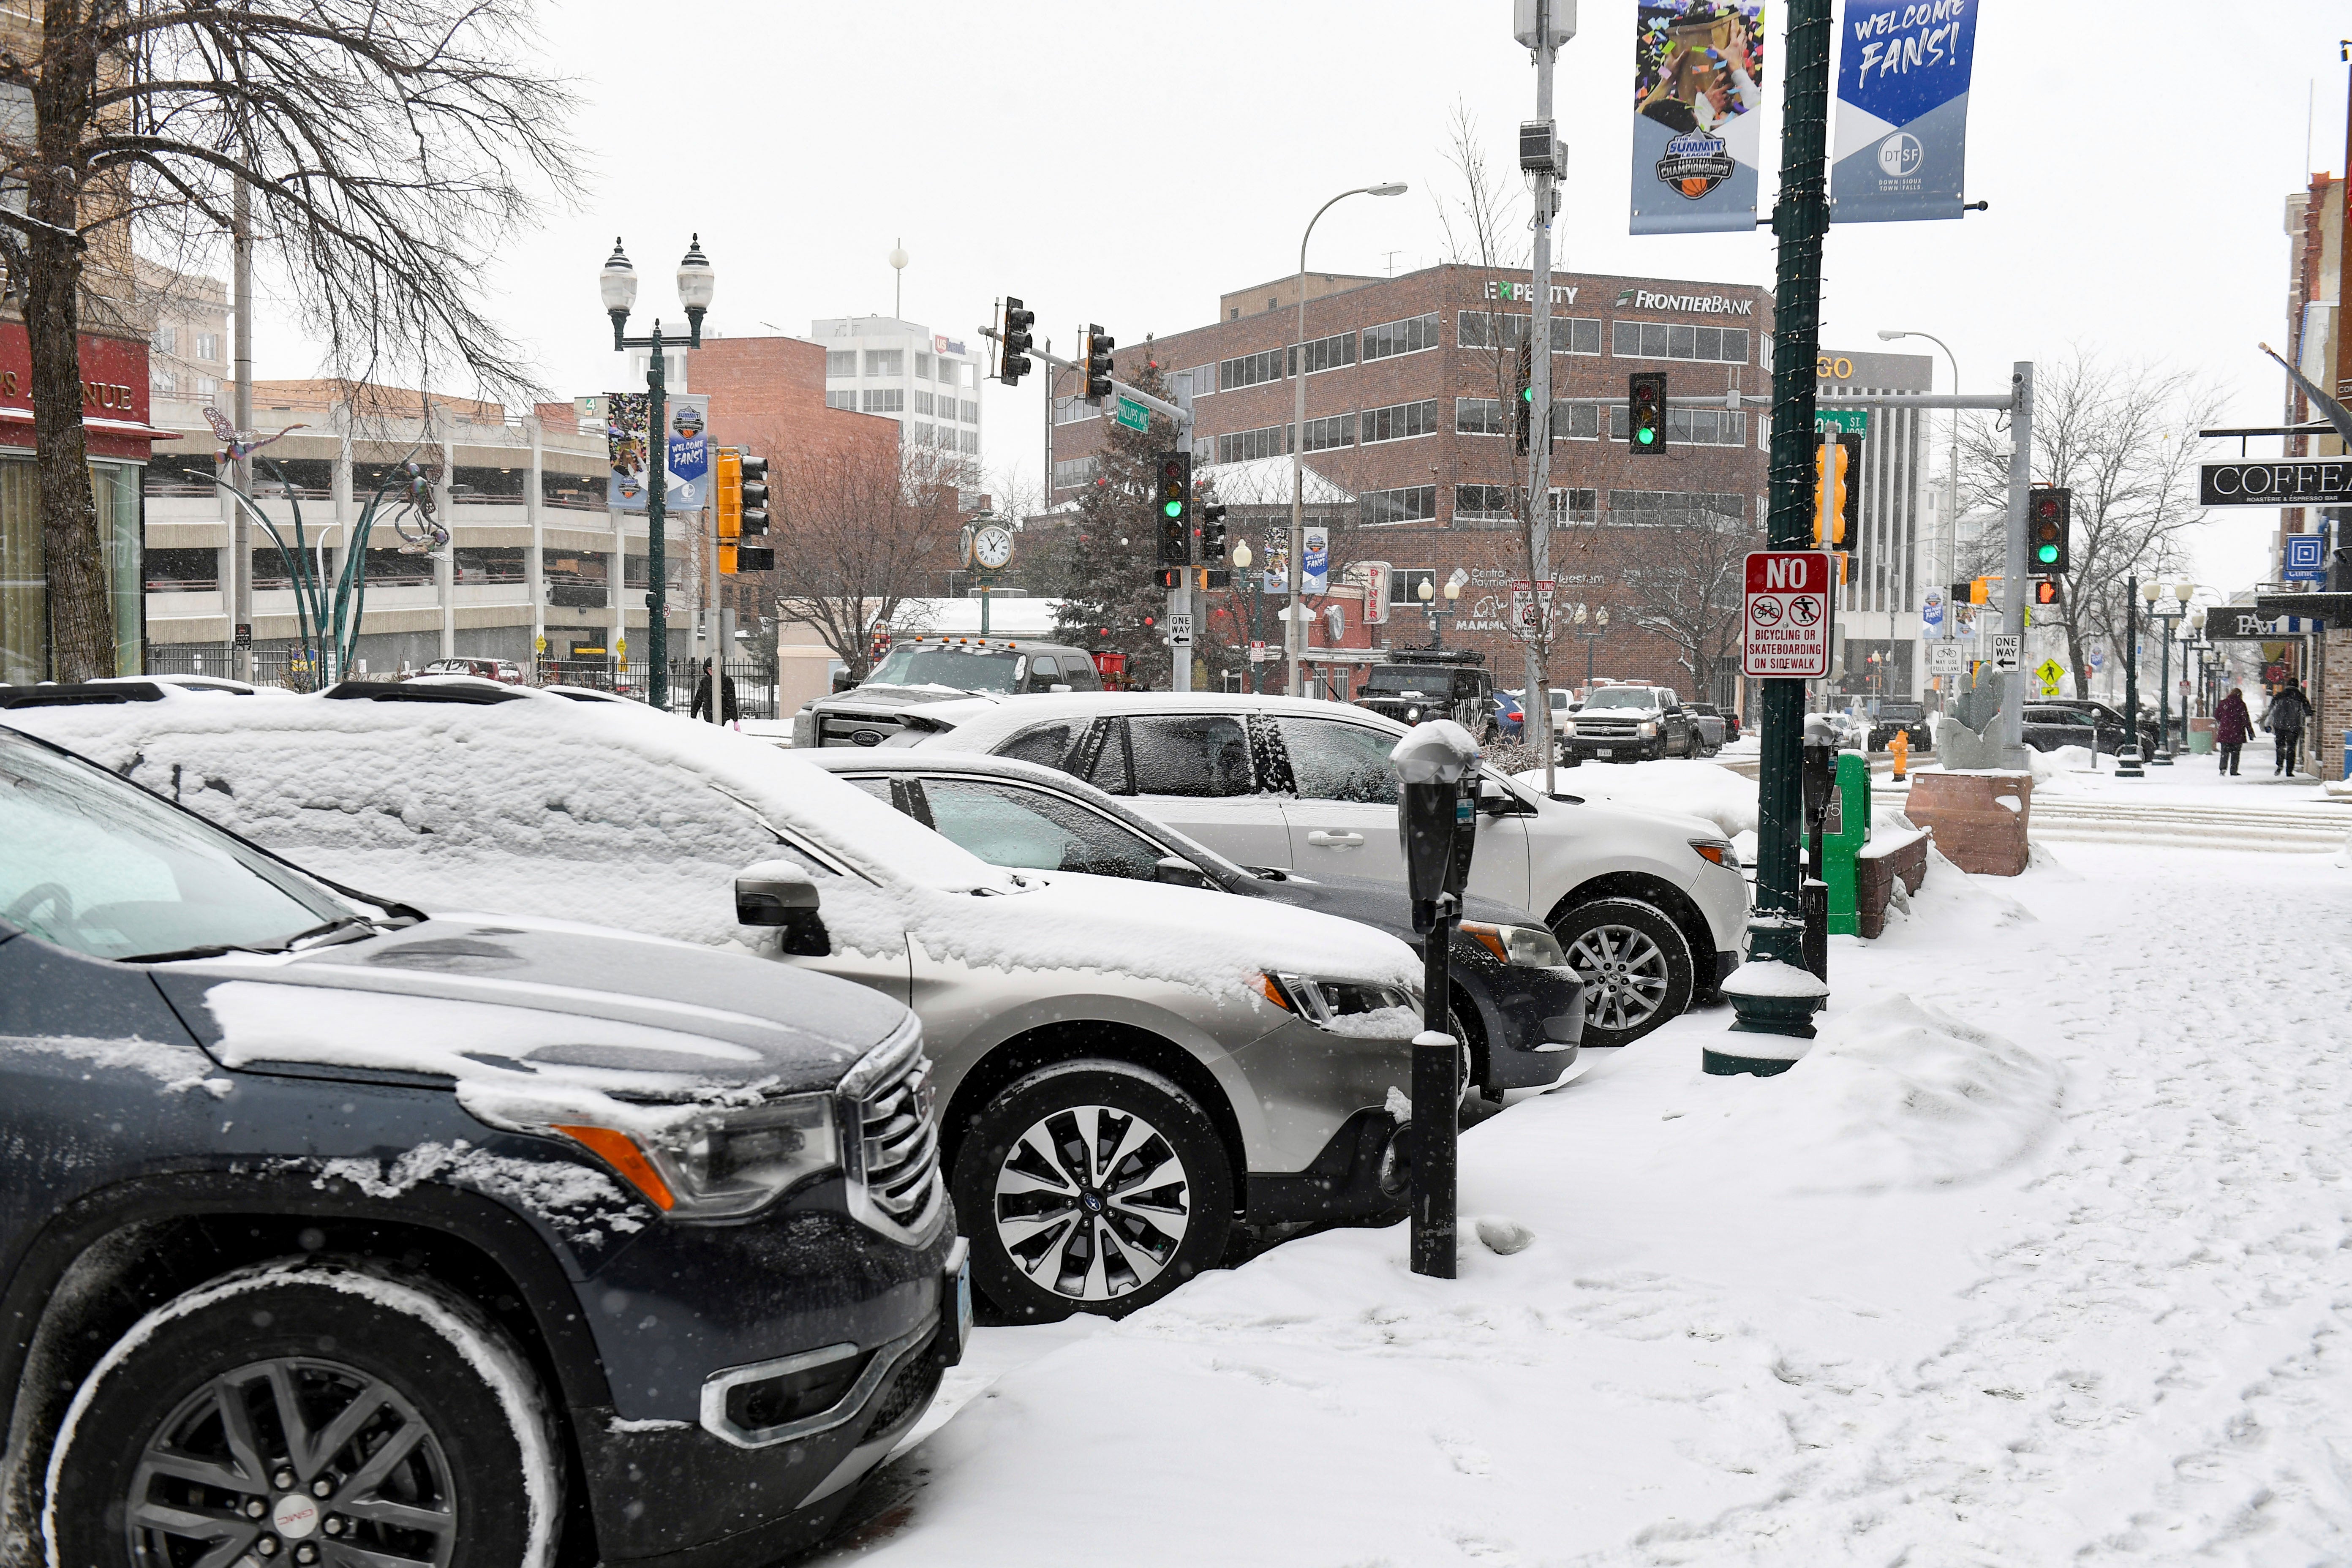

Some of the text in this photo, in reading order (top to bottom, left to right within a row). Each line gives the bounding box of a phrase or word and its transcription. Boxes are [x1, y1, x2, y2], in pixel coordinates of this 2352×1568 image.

[1854, 0, 1964, 41] WELCOME
[1859, 22, 1960, 89] FANS!
[1669, 140, 1722, 153] SUMMIT
[1661, 163, 1729, 177] CHAMPIONSHIPS
[1484, 281, 1579, 304] EXPEITY
[586, 399, 596, 409] 4
[1119, 403, 1148, 427] PHILLIPS AVE
[672, 439, 704, 452] WELCOME
[674, 449, 703, 468] FANS!
[1307, 558, 1325, 569] FANS!
[1472, 568, 1506, 577] Central
[1551, 572, 1605, 584] Bluestem
[1767, 558, 1807, 588] NO
[1513, 582, 1554, 591] PANHDLING
[1369, 569, 1378, 619] DINER
[1755, 630, 1815, 640] BICYCLING OR
[1996, 637, 2017, 646] ONE
[1749, 644, 1821, 655] SKATEBOARDING
[1996, 648, 2017, 657] WAY
[1755, 658, 1814, 669] ON SIDEWALK
[858, 733, 875, 742] Ford
[277, 1509, 313, 1525] GMC
